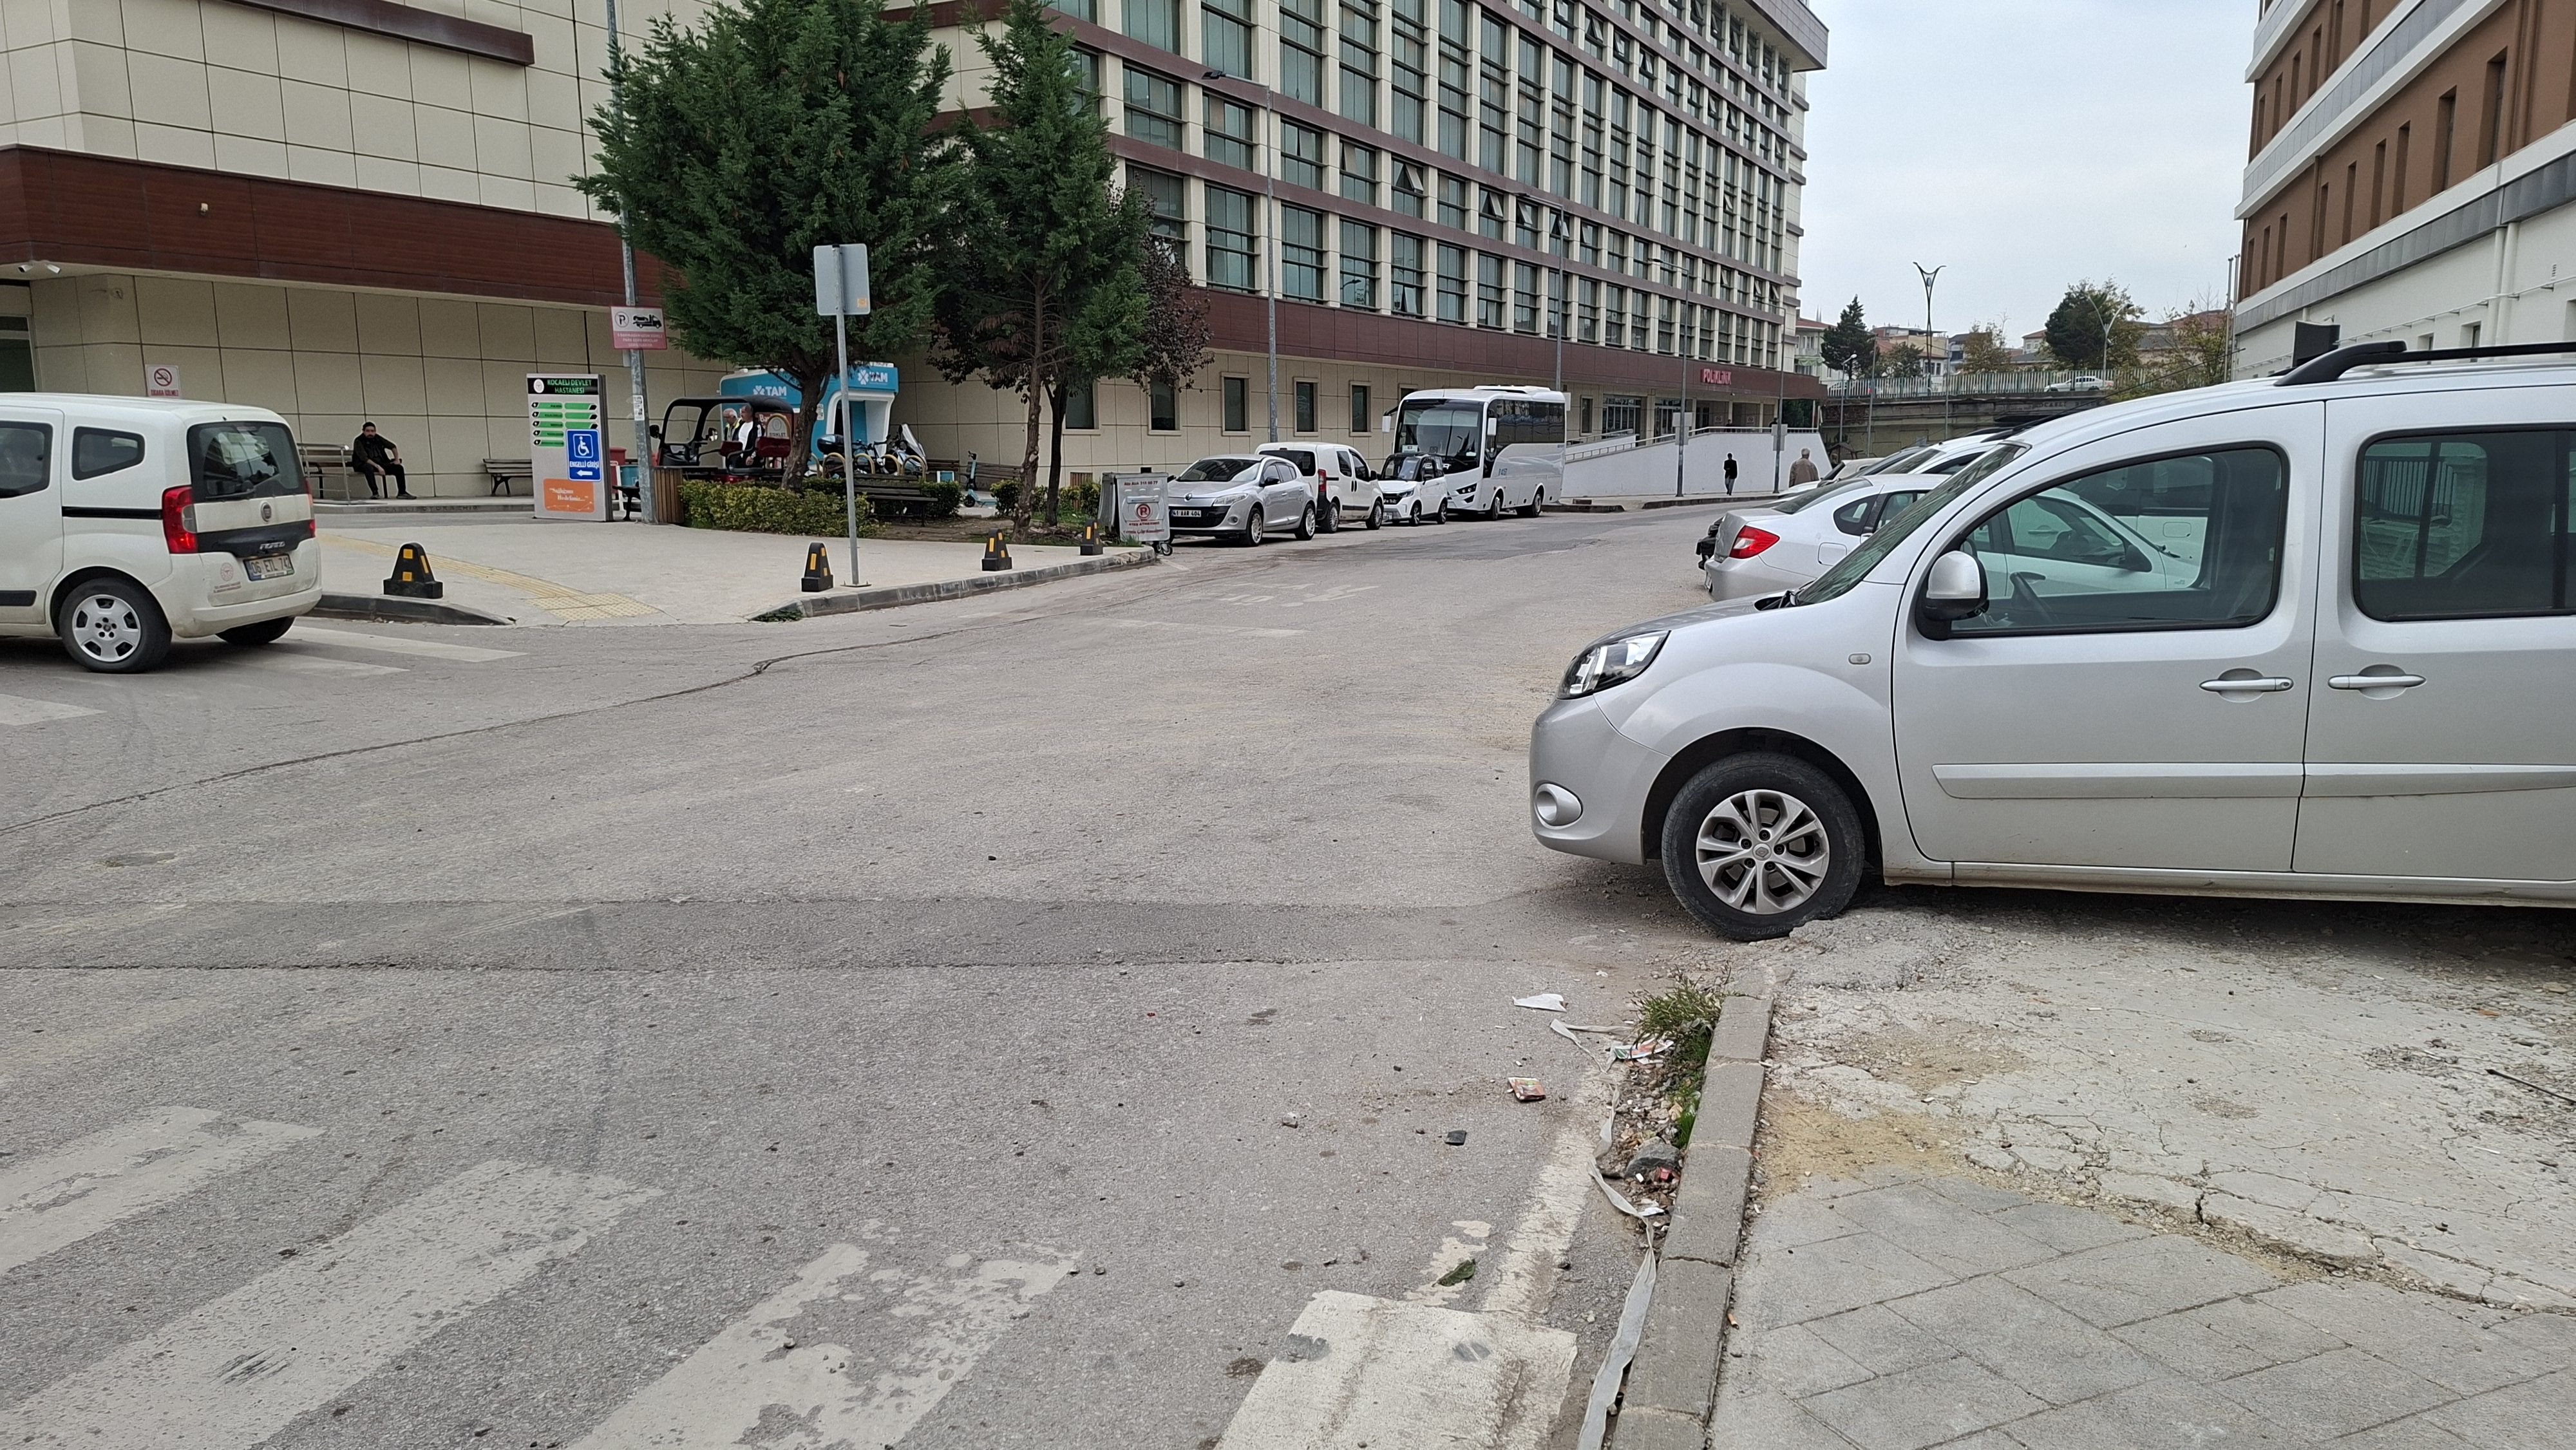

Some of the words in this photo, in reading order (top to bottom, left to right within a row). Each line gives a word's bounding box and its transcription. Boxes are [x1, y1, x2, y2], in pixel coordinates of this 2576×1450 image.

[869, 372, 888, 383] TAM
[766, 386, 787, 397] TAM
[263, 558, 278, 572] ETL
